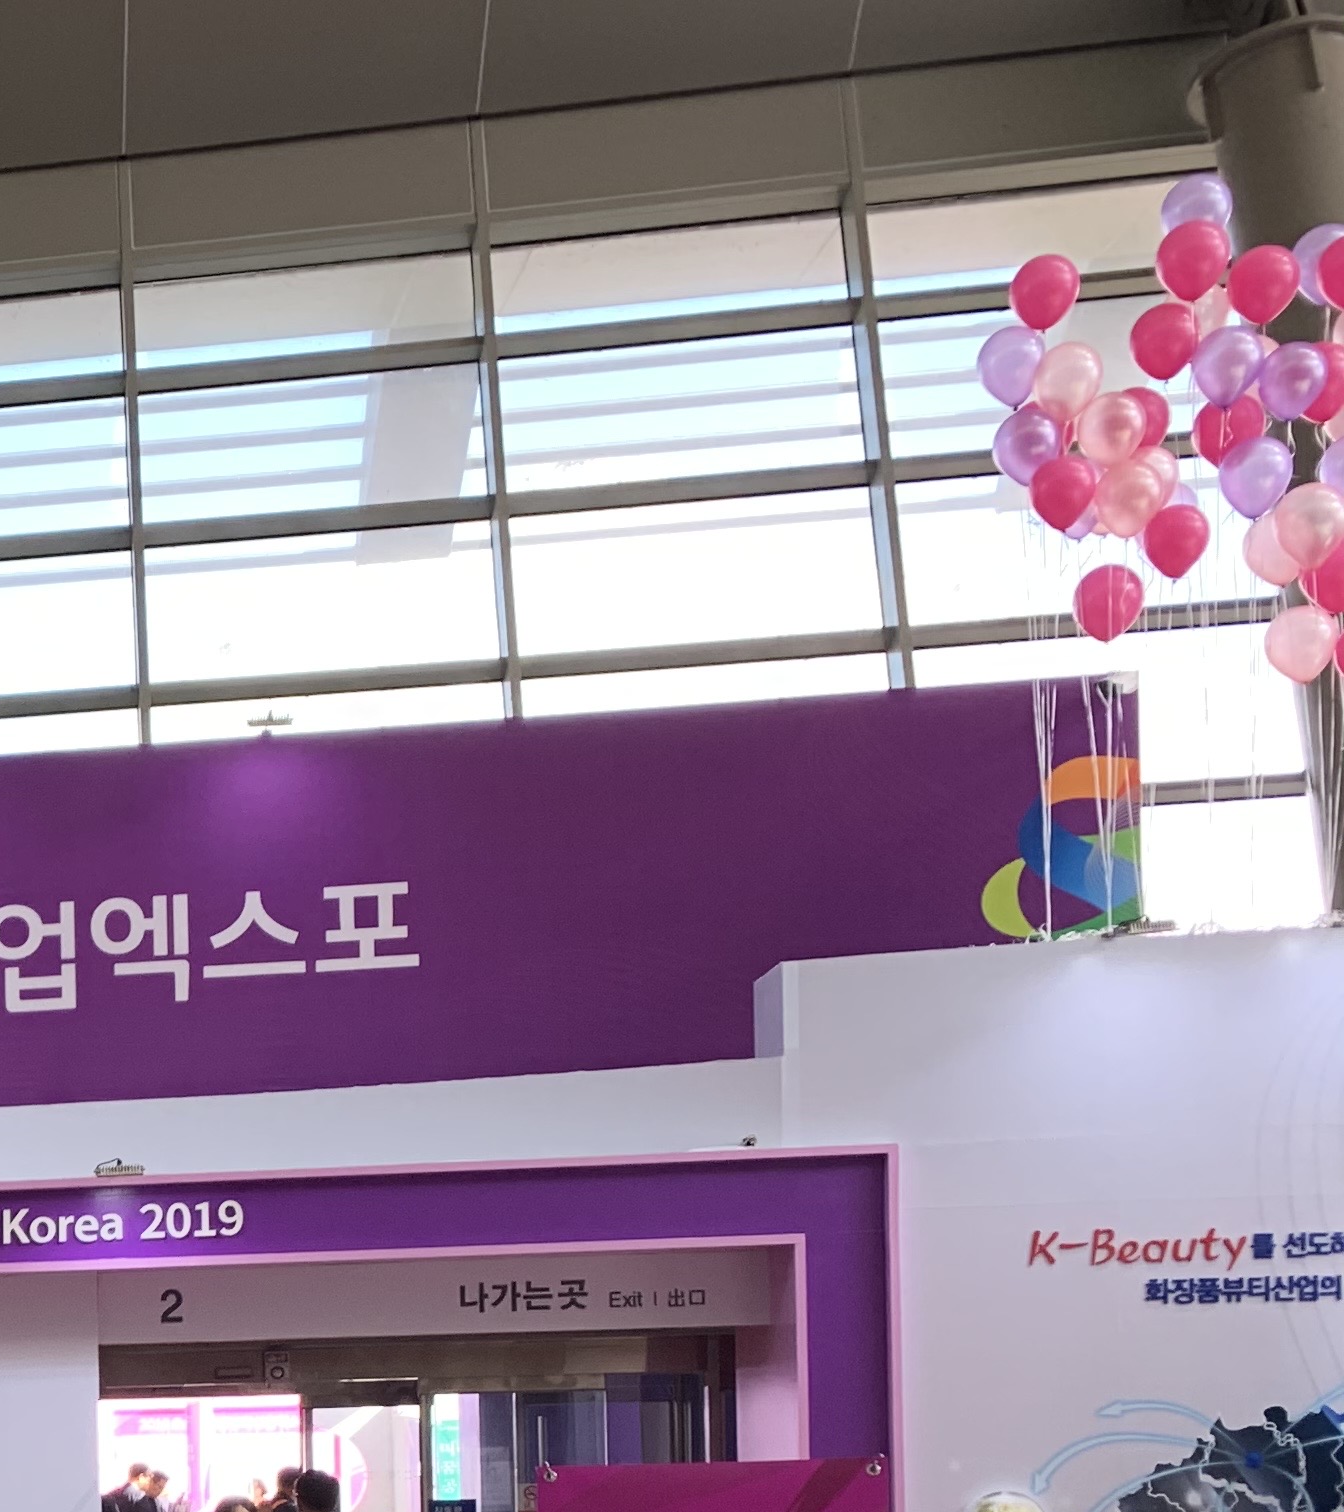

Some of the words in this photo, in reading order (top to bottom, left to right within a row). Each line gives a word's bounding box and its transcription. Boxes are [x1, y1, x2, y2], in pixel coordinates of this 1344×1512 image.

[1, 1204, 124, 1245] Korea
[138, 1199, 245, 1241] 2019
[160, 1289, 183, 1322] 2
[459, 1279, 589, 1313] 나가는곳
[608, 1290, 644, 1308] Exit
[667, 1287, 706, 1308] 出口
[1144, 1275, 1342, 1305] 화장품뷰티산업의
